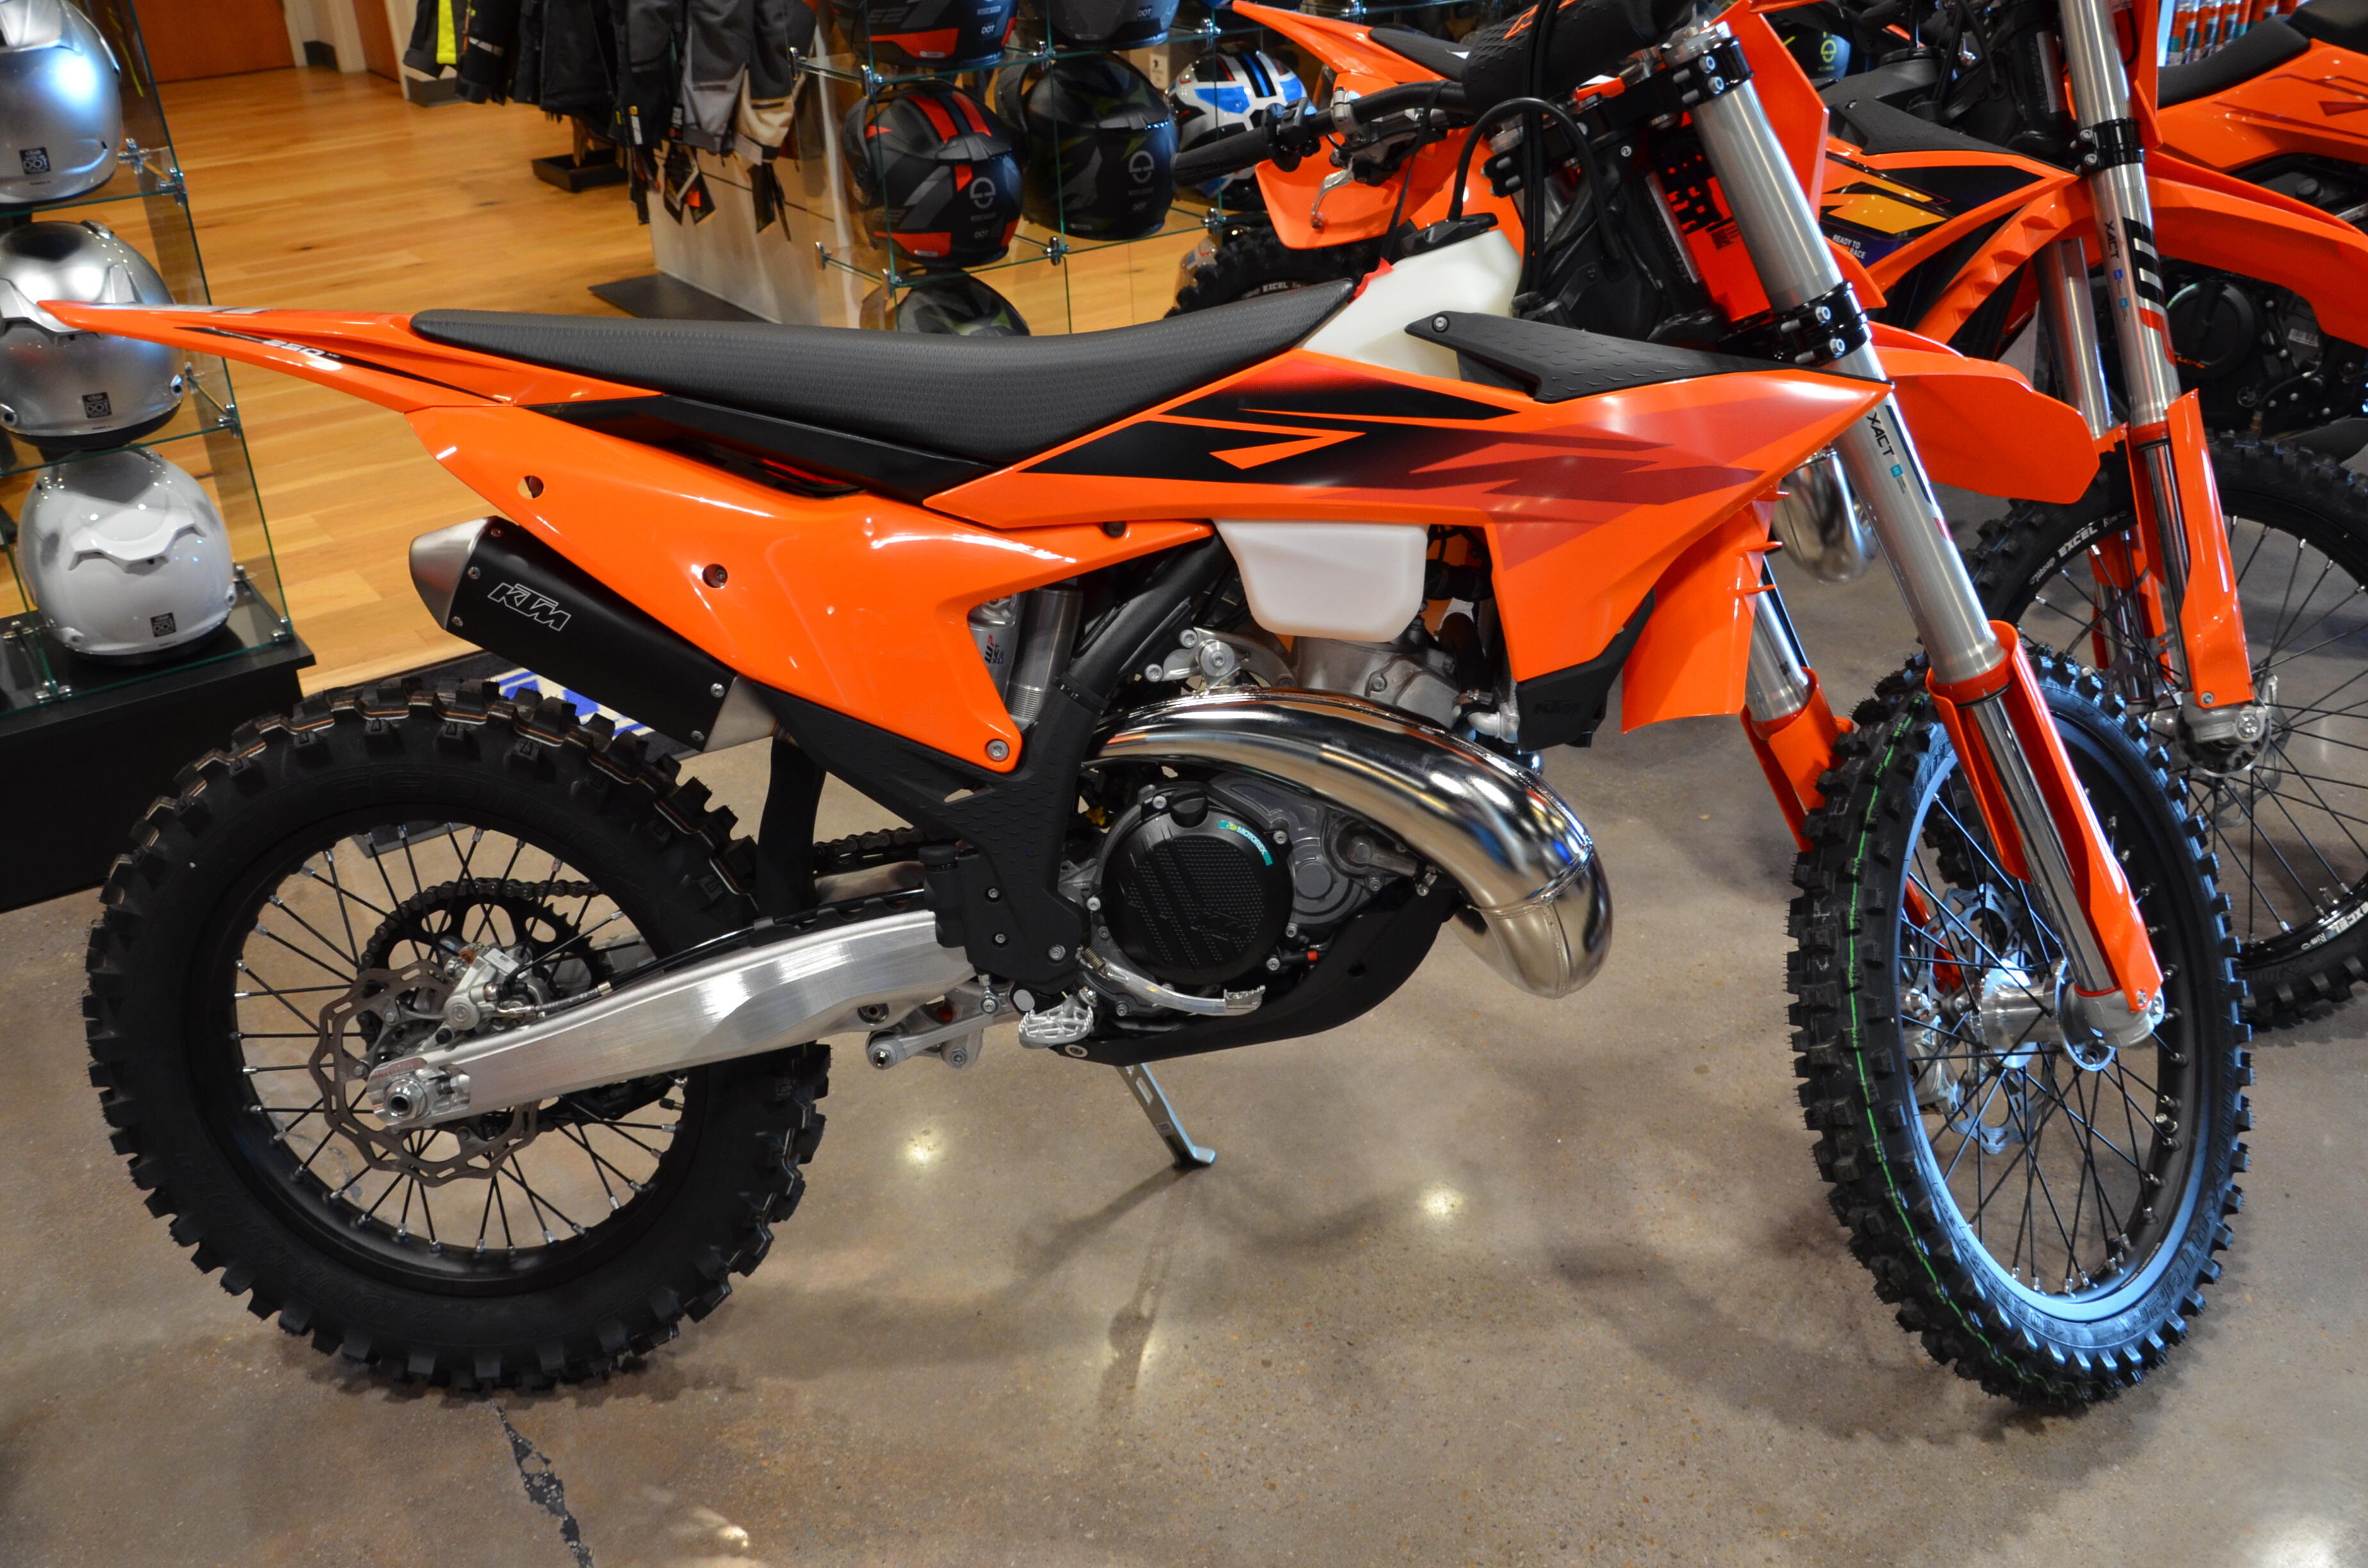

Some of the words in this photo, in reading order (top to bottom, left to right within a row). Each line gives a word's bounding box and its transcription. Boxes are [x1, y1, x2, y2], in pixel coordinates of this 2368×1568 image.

[1137, 8, 1152, 17] DOT
[981, 24, 996, 34] DOT
[1832, 234, 1852, 246] READY
[1852, 240, 1861, 249] TO
[2105, 220, 2120, 259] XACT
[1849, 247, 1866, 259] RACE
[263, 339, 325, 357] 250
[1866, 411, 1895, 455] XACT
[2057, 527, 2098, 558] EXCEL
[487, 582, 571, 632] KTM
[1237, 826, 1266, 856] MOTOREX
